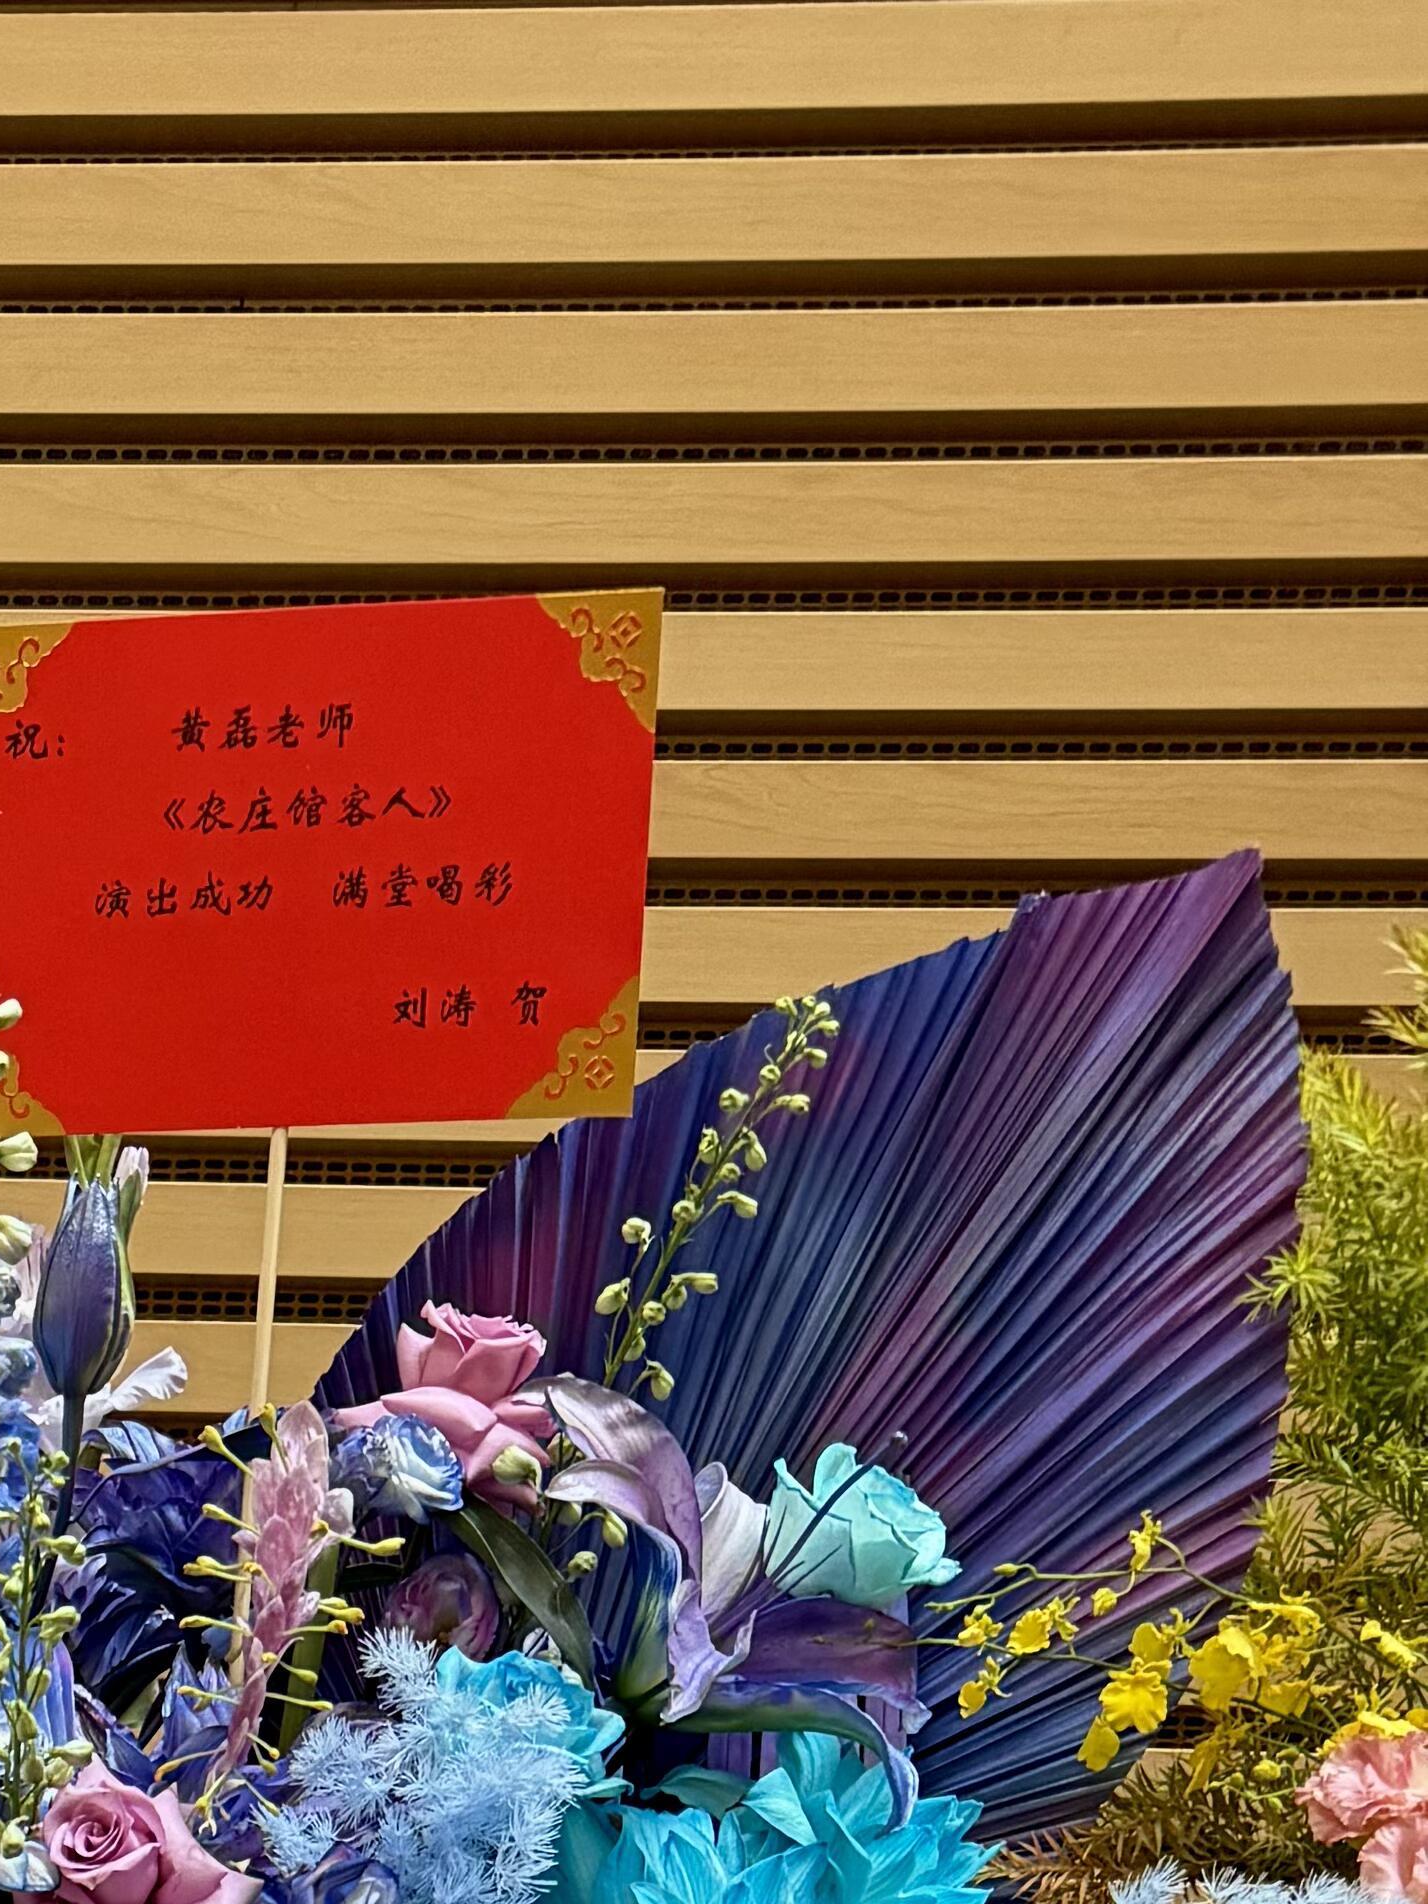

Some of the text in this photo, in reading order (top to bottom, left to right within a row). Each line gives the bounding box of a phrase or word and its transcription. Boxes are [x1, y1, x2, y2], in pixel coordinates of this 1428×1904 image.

[172, 703, 354, 752] 黄磊老师
[163, 783, 451, 835] 《农庄馆客人》
[95, 862, 513, 919] 演出成功 满堂喝彩
[393, 981, 548, 1029] 刘涛 贺
